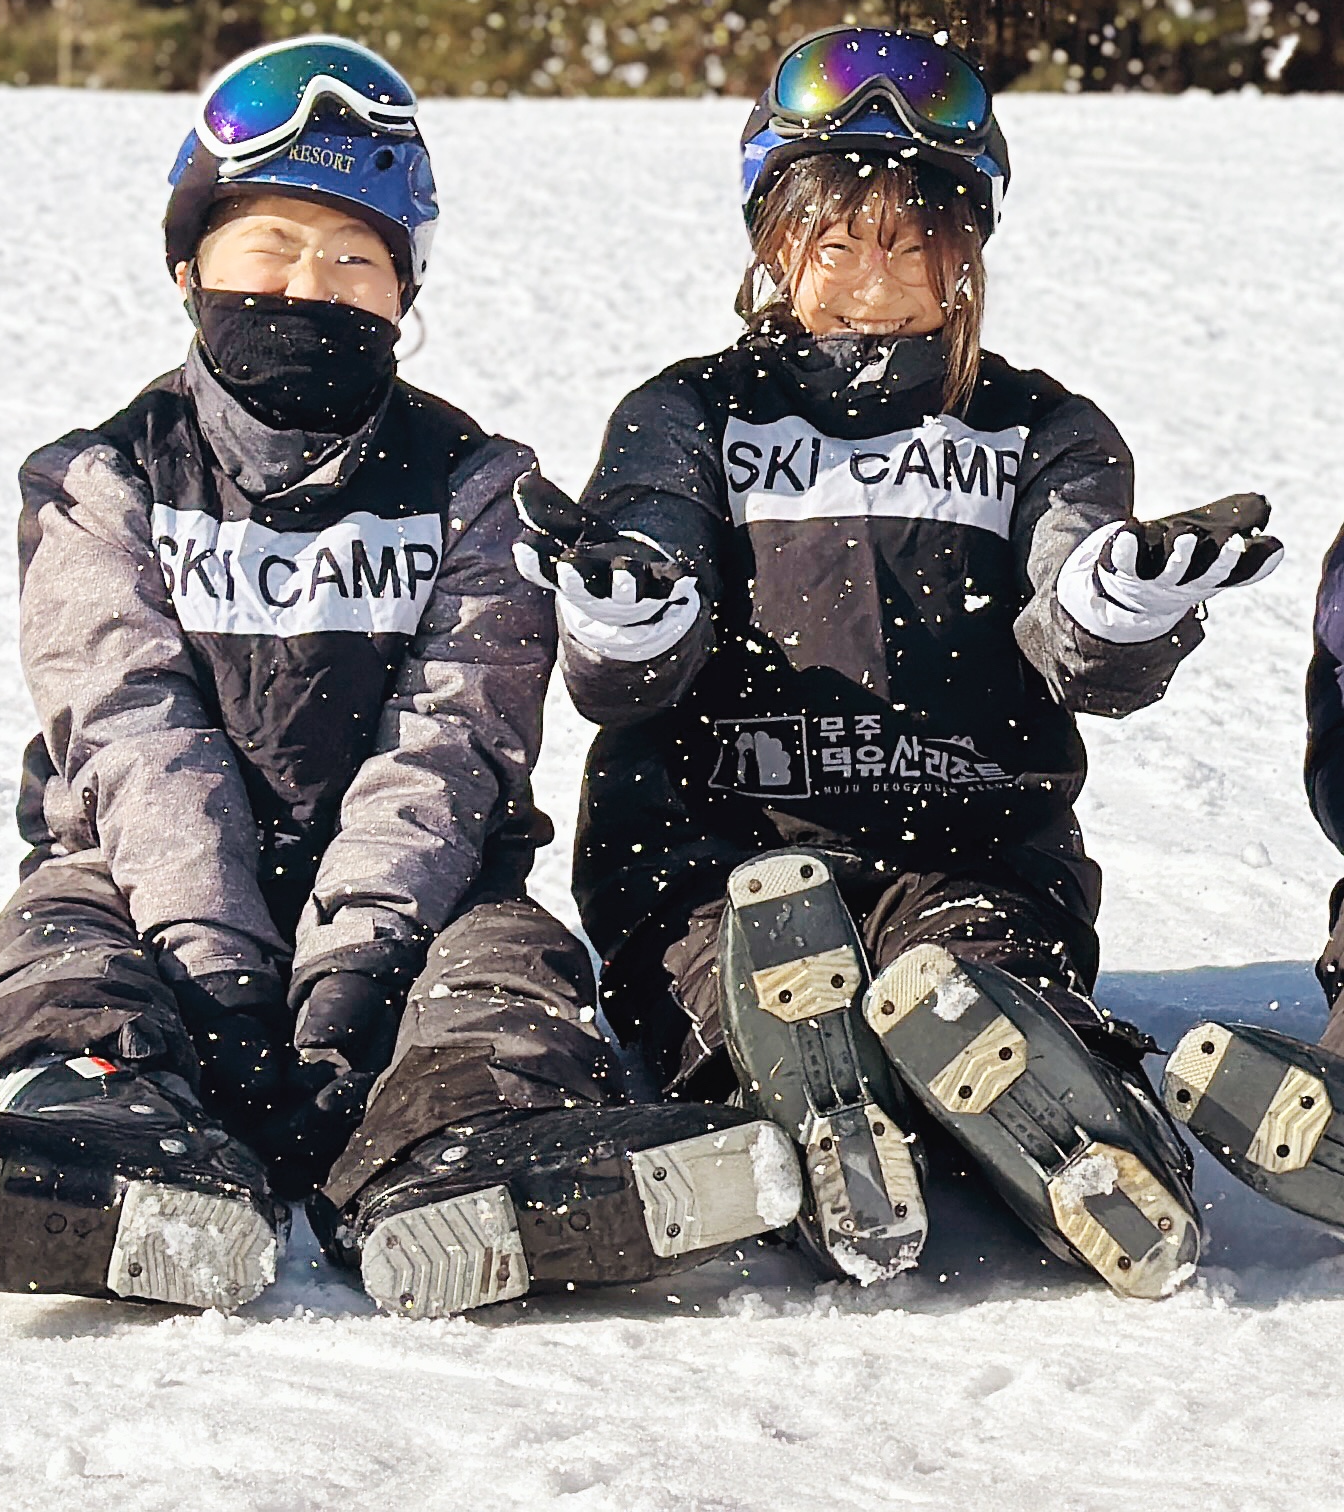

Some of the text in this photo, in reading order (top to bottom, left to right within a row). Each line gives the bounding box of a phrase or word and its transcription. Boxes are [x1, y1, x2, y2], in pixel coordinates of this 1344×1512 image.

[288, 144, 356, 175] RESORT
[727, 436, 1021, 502] SKI CAMP
[158, 535, 439, 609] SKI CAMP
